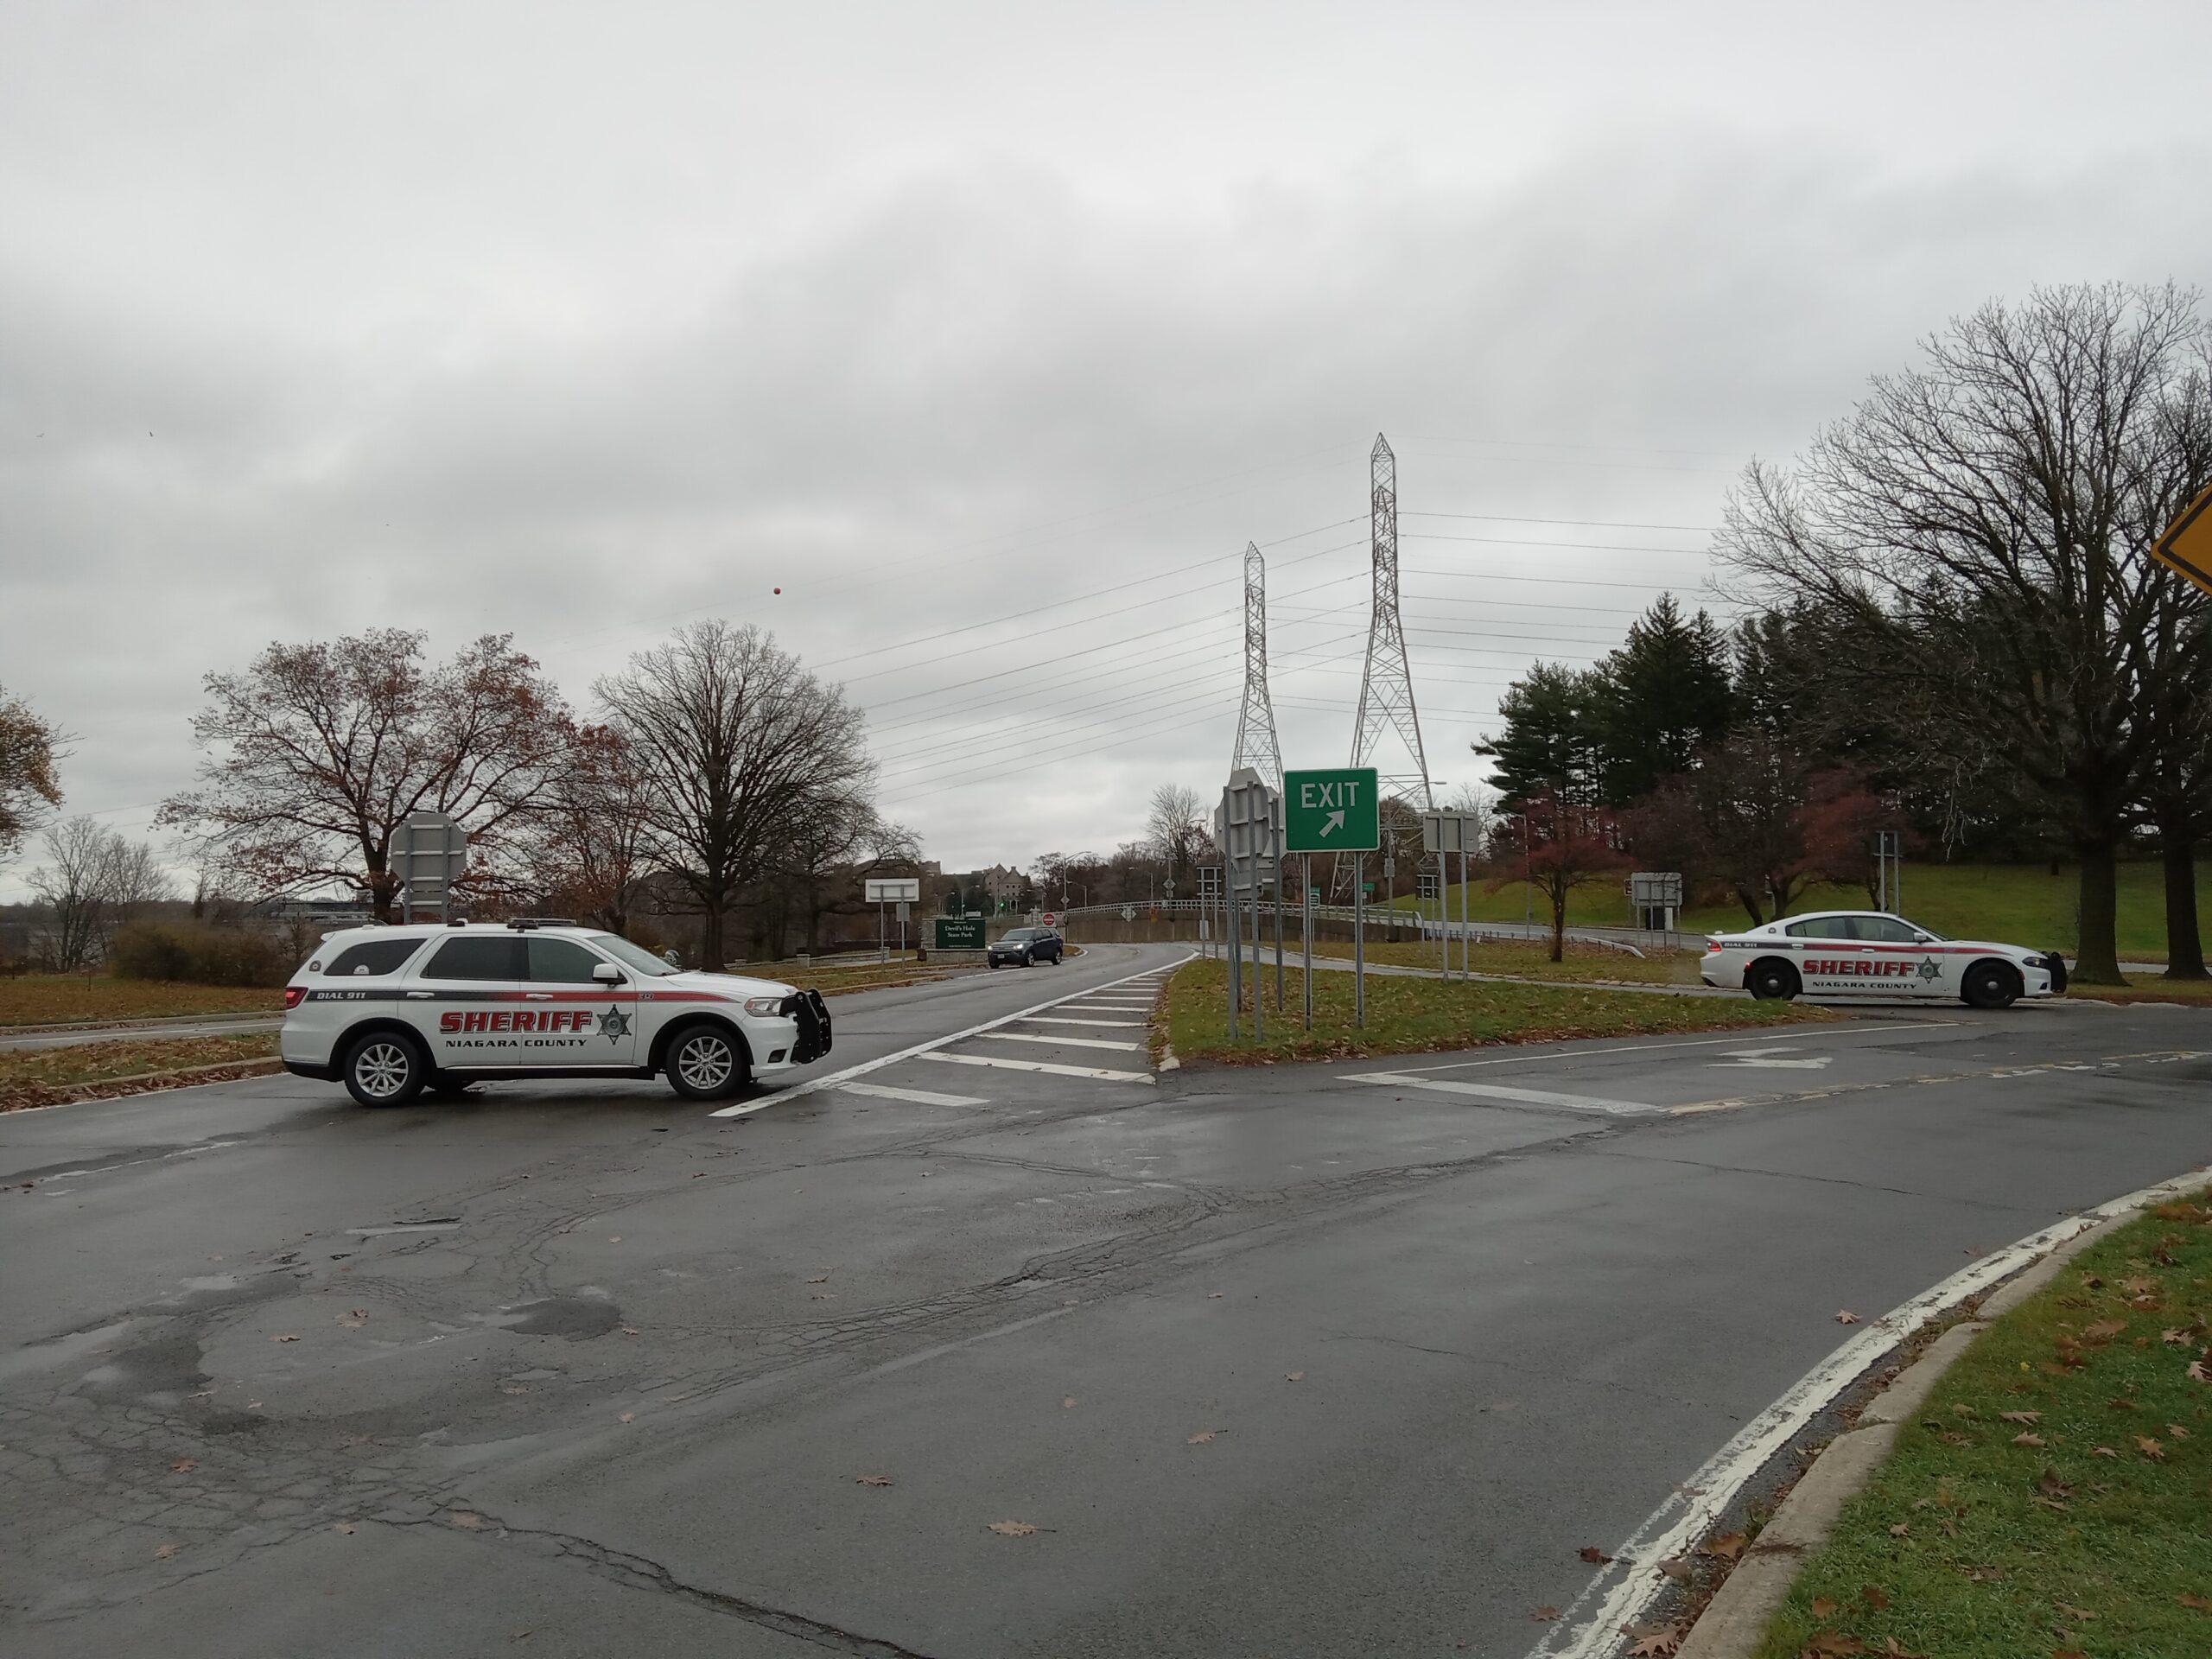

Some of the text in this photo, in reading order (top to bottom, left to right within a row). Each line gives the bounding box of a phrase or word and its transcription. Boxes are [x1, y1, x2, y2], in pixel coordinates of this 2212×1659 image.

[1301, 782, 1359, 808] EXIT
[1802, 960, 1916, 977] SHERIFF
[440, 1010, 593, 1033] SHERIFF
